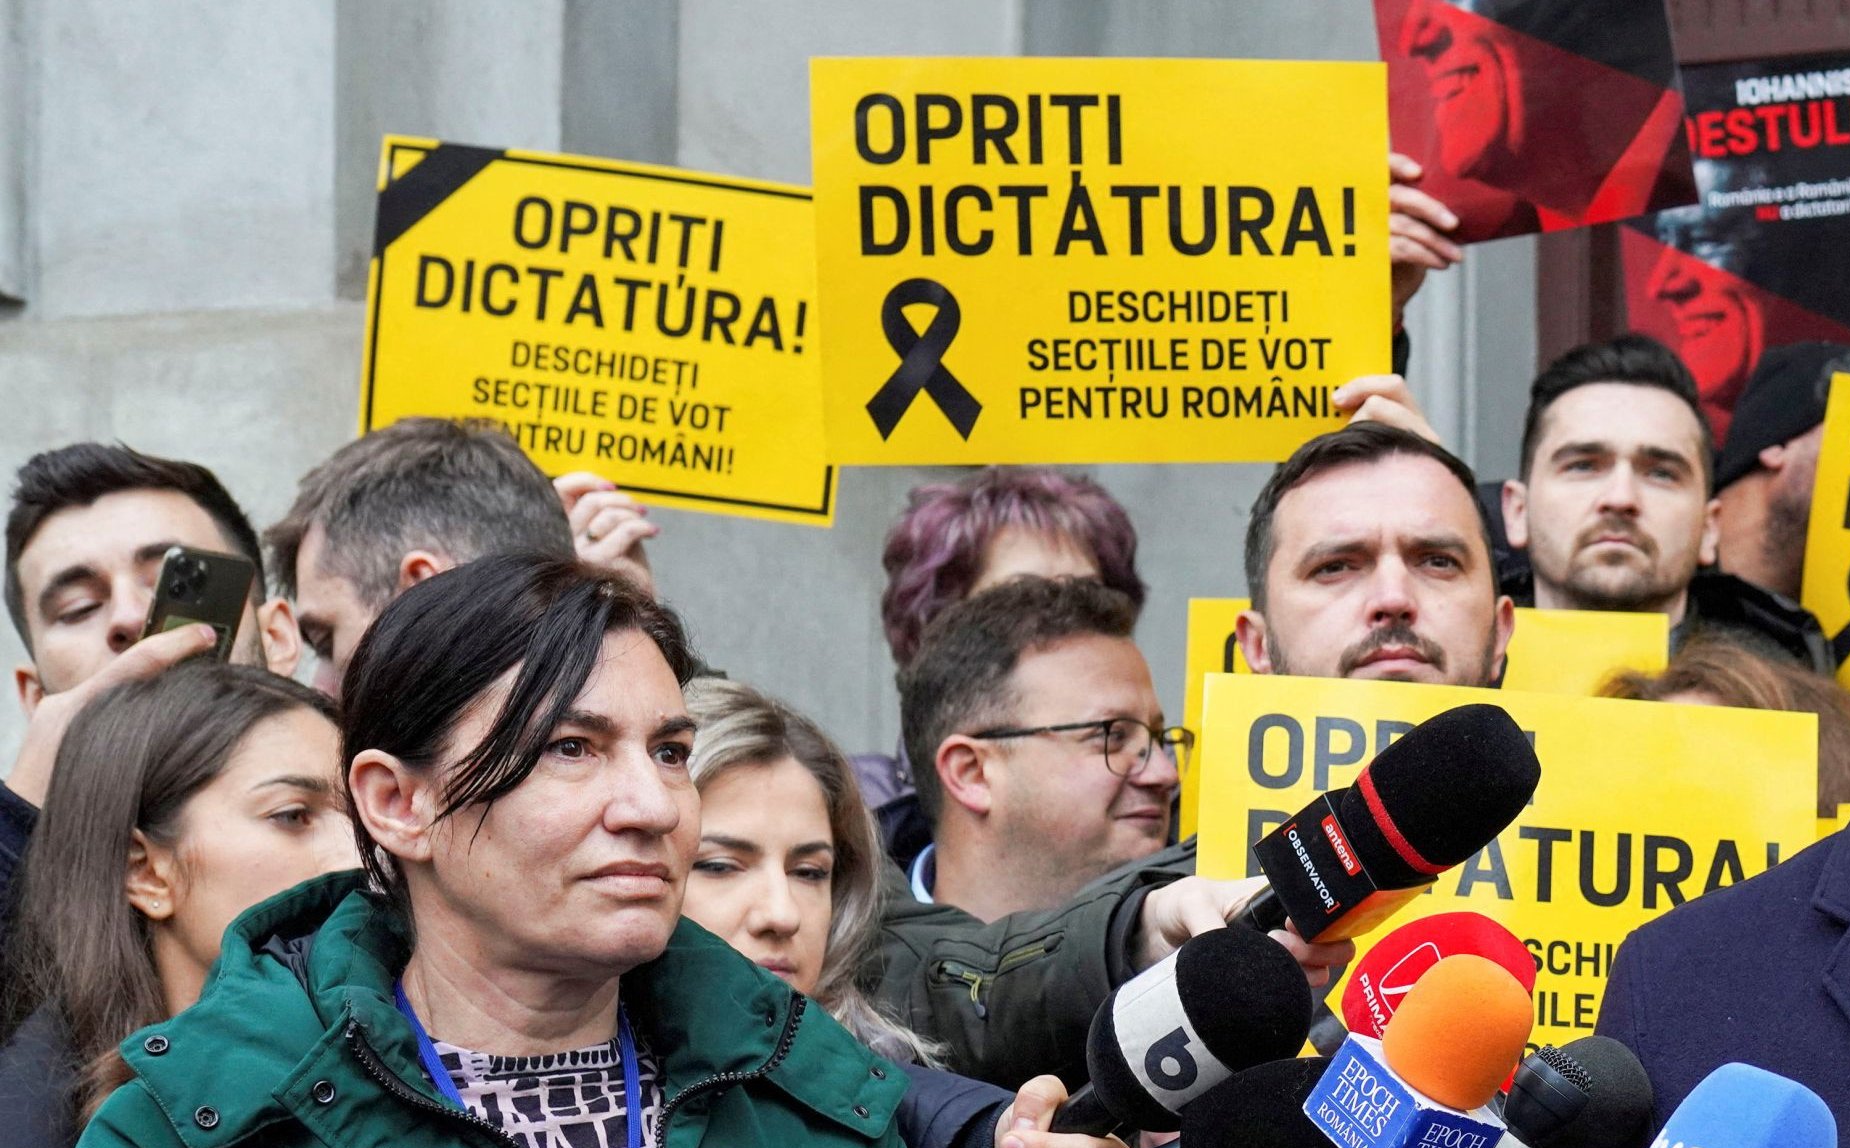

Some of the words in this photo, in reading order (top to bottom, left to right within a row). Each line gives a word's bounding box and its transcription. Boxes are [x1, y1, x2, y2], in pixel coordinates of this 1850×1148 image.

[855, 92, 1122, 184] OPRIȚI
[513, 195, 725, 288] OPRIȚI
[858, 184, 1357, 258] DICTATURA!
[415, 255, 807, 355] DICTATURA!
[1068, 290, 1289, 334] DESCHIDEȚI
[511, 341, 700, 396] DESCHIDEȚI
[1027, 338, 1189, 382] SECȚIILE
[1201, 339, 1246, 371] DE
[1258, 338, 1332, 371] VOT
[472, 377, 608, 420] SECȚIILE
[618, 395, 658, 423] DE
[668, 399, 731, 433] VOT
[1019, 387, 1169, 419] PENTRU
[597, 431, 735, 475] ROMÂNI!
[1325, 823, 1354, 871] antena
[1331, 1075, 1388, 1138] TIMES
[1341, 1056, 1401, 1121] EPOCH
